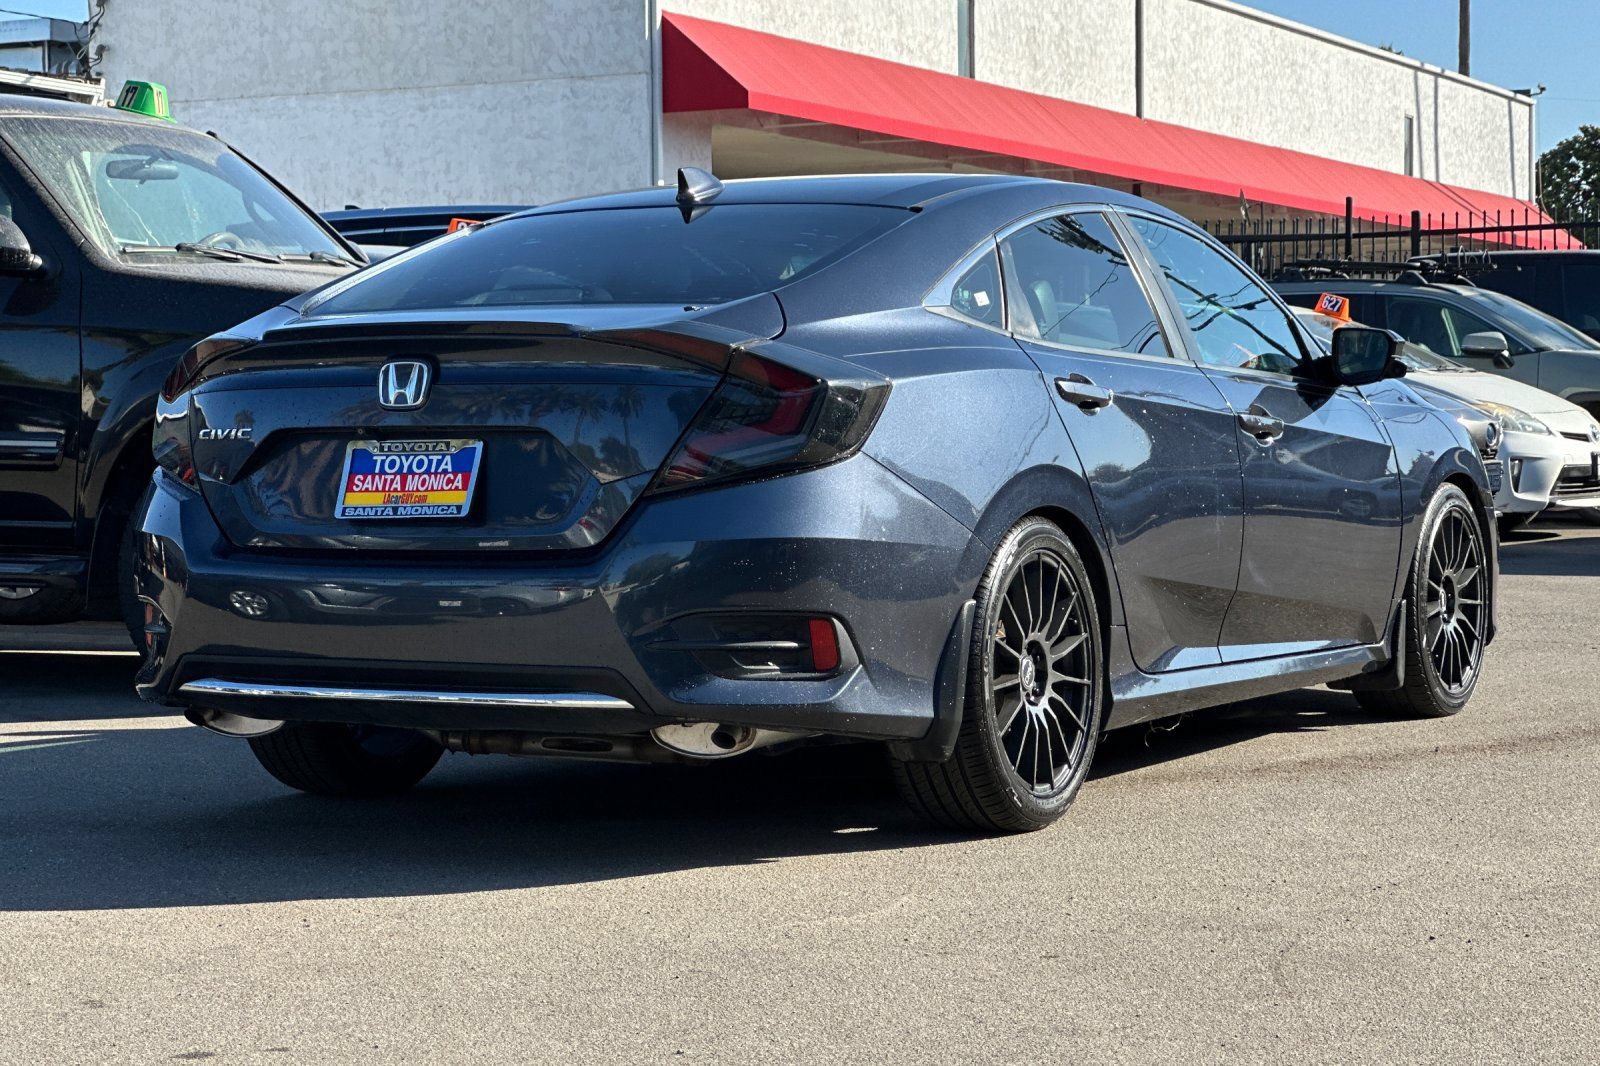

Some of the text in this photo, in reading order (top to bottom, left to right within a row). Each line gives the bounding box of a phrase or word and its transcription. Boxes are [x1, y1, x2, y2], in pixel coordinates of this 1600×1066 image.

[121, 85, 139, 108] 17
[1321, 295, 1343, 312] 627
[199, 428, 251, 440] CIVIC
[382, 442, 448, 452] TOYOTA
[372, 455, 453, 473] TOYOTA
[353, 473, 462, 491] SANTA MONICA
[345, 505, 457, 516] SANTA MONICA
